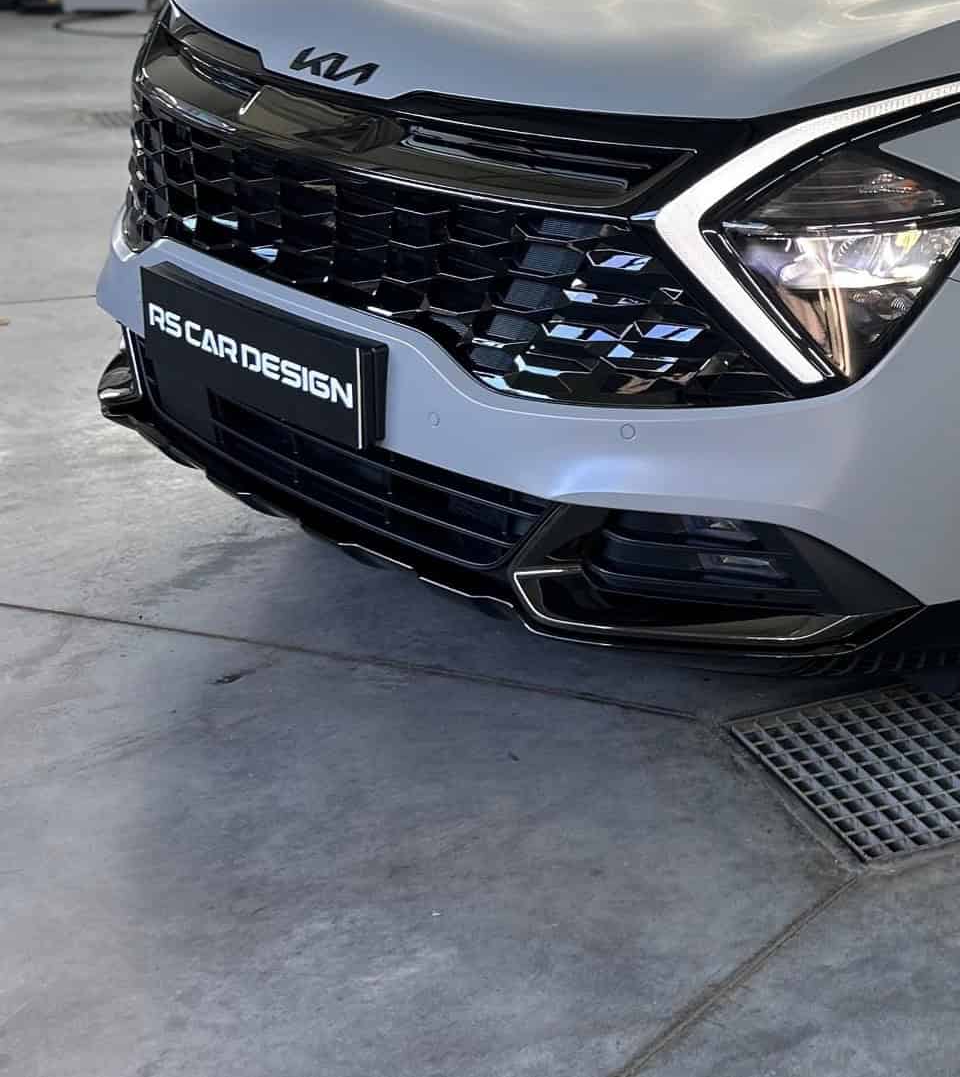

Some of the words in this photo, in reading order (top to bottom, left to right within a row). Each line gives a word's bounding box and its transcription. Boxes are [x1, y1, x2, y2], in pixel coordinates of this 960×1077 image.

[289, 46, 380, 86] KIA
[148, 303, 182, 339] RS
[184, 320, 238, 365] CAR
[240, 343, 355, 409] DESIGN
